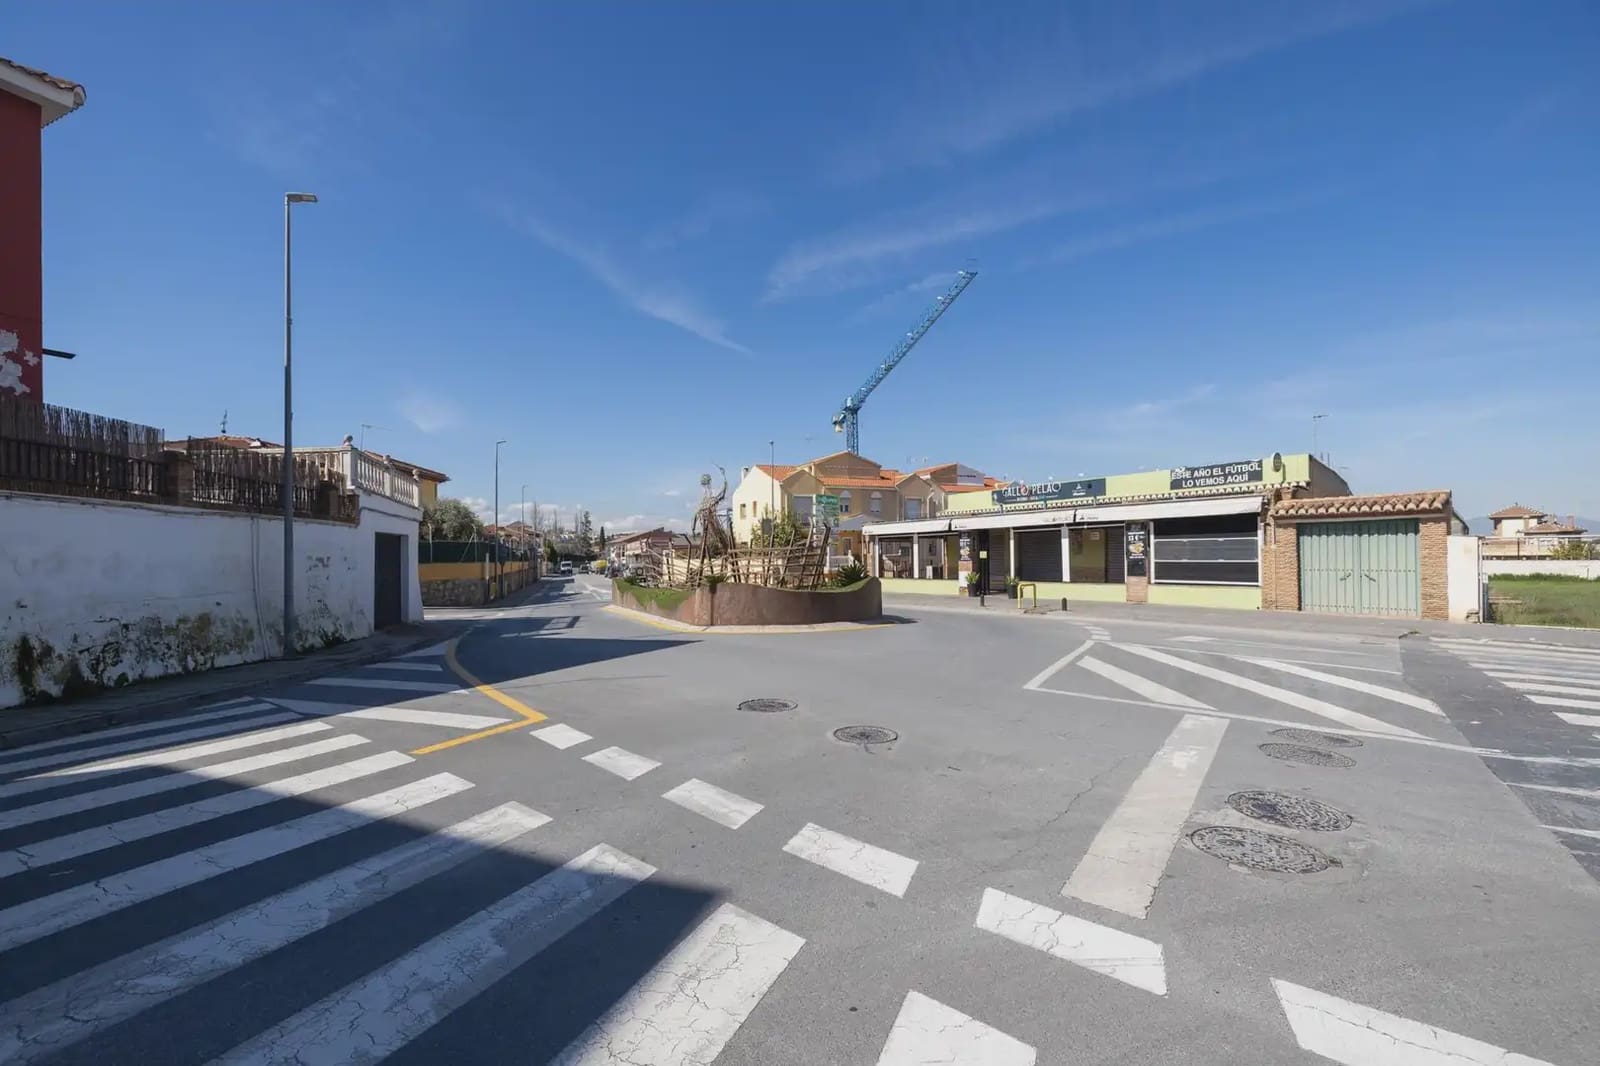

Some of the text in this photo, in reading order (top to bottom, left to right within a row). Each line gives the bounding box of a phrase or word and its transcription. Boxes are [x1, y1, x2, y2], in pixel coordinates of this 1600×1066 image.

[1171, 463, 1261, 480] ESTE AÑO EL FÚTBOL
[1182, 473, 1248, 488] LO VEMOS AQUÍ
[1002, 483, 1029, 497] GALLO
